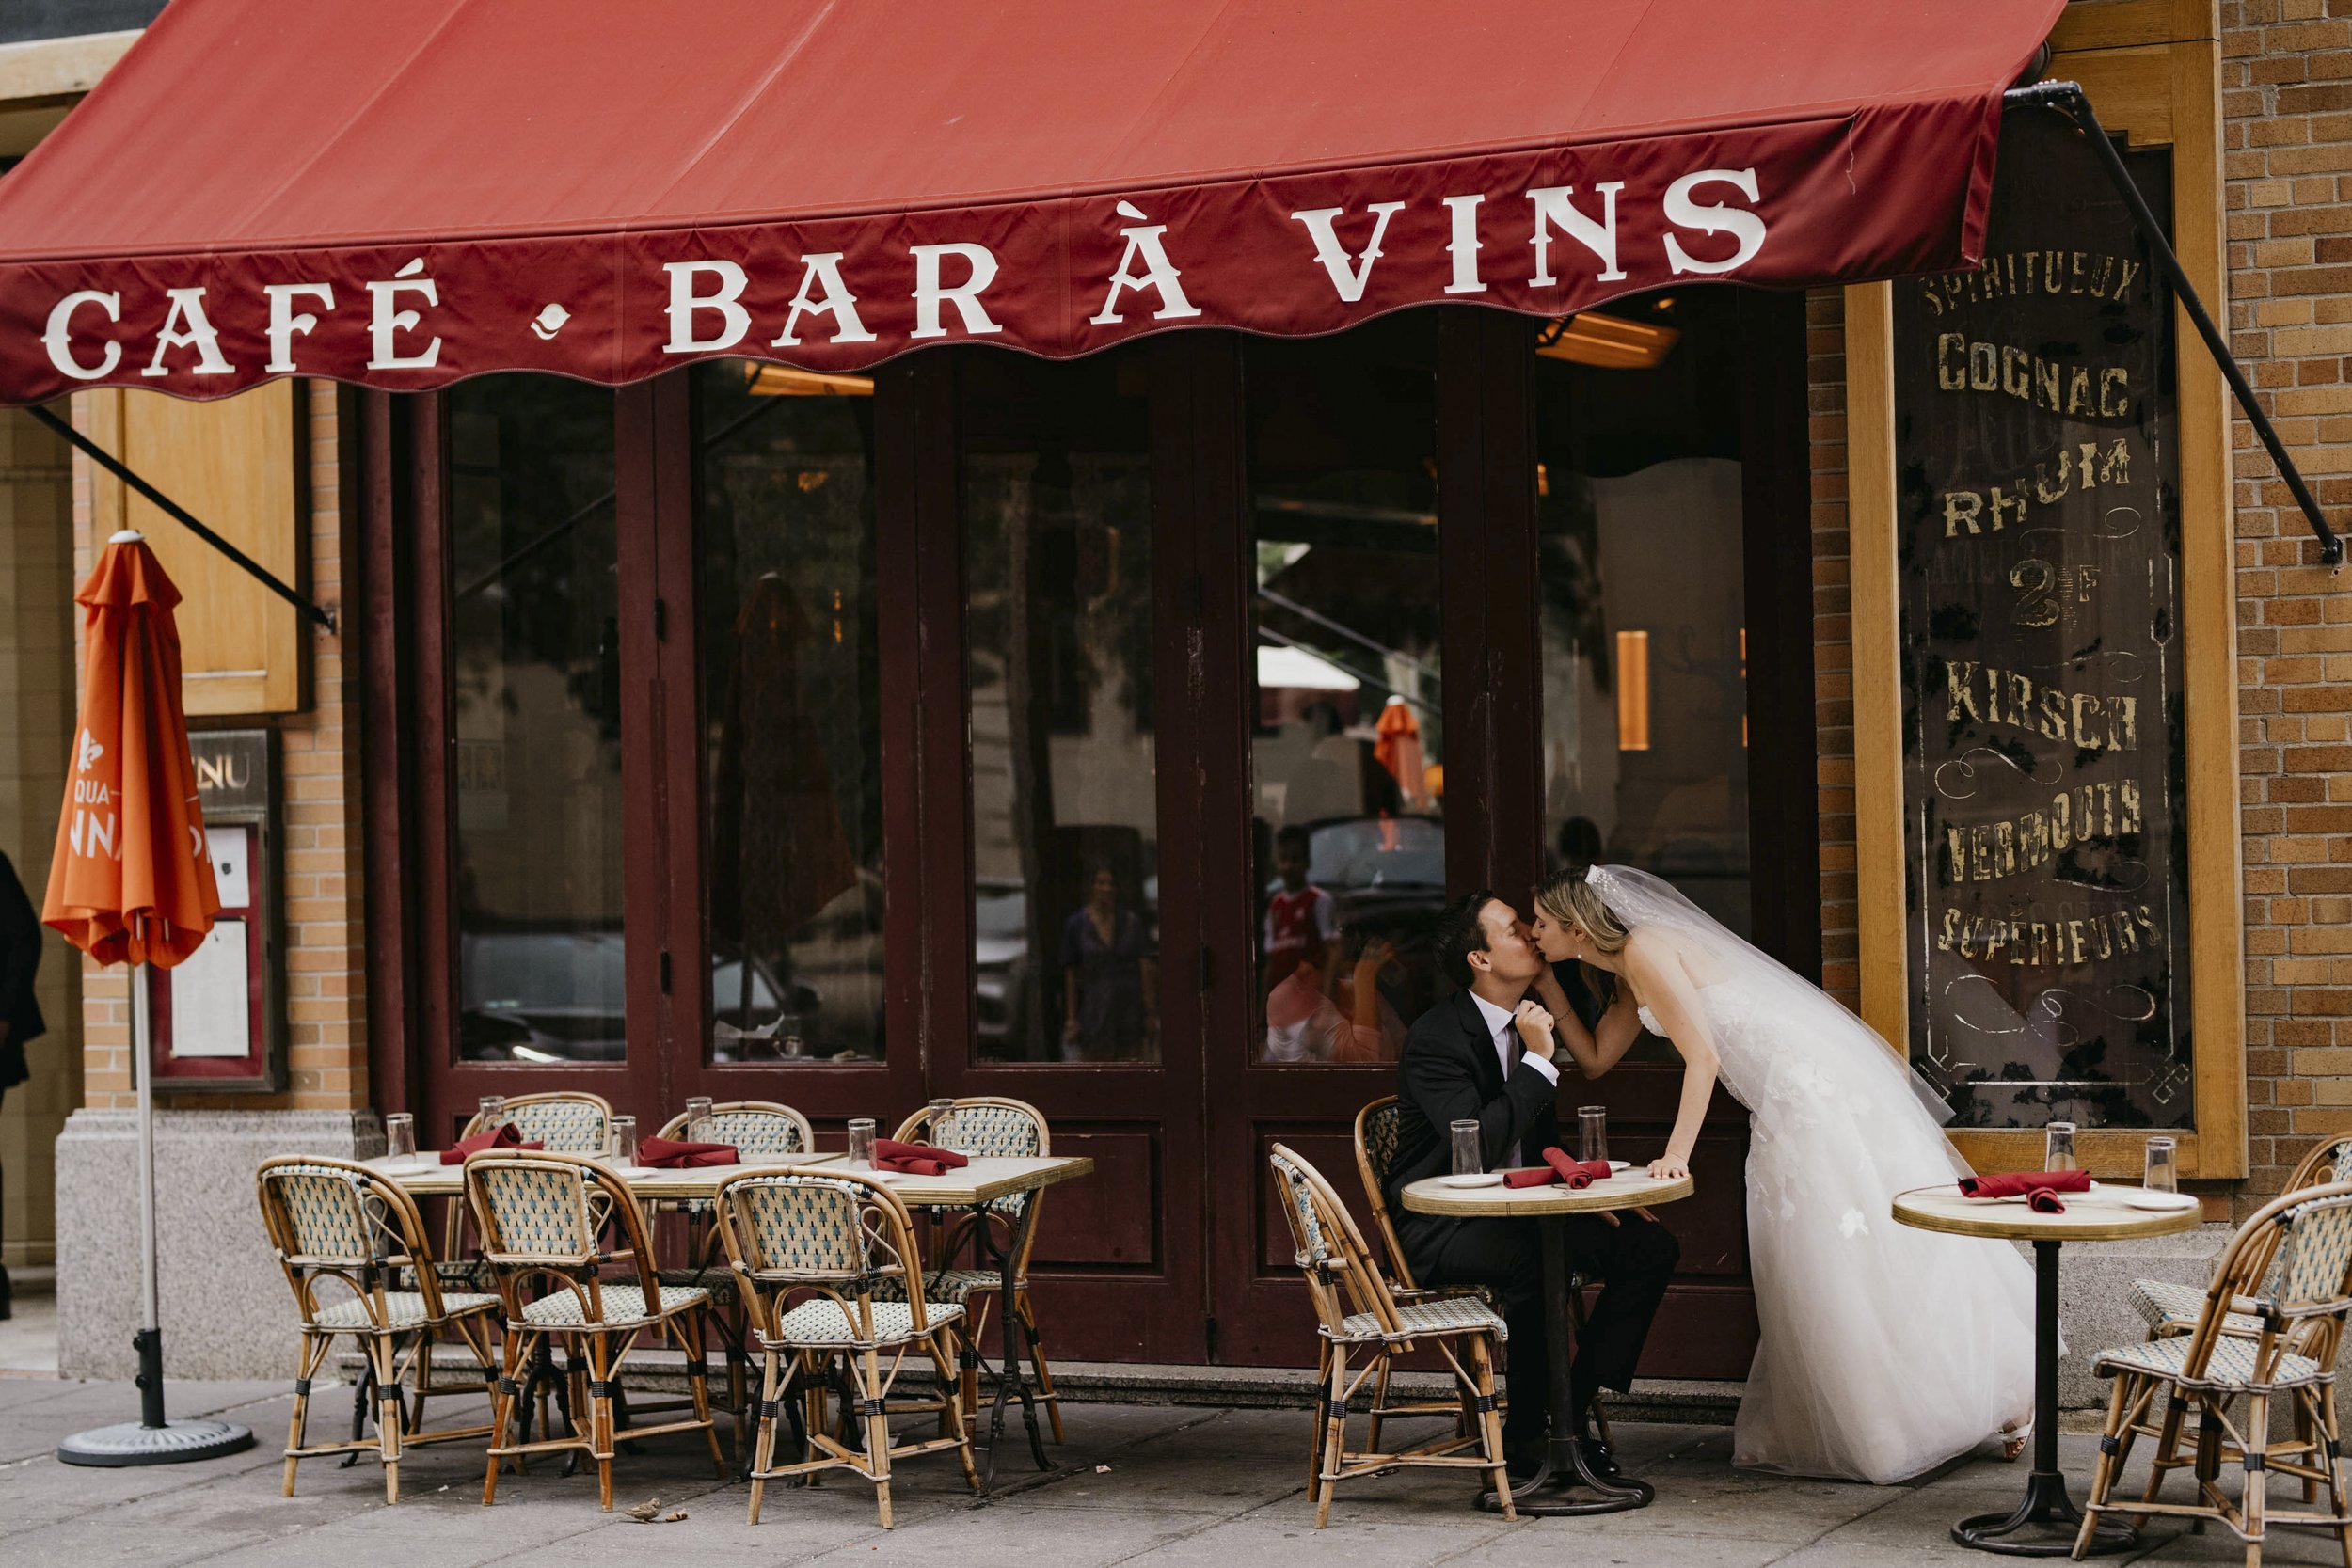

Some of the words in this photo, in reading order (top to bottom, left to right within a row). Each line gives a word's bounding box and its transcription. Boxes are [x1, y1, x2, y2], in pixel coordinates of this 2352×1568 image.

[40, 257, 442, 380] CAFÉ
[661, 242, 1004, 354] BAR
[1089, 199, 1202, 325] À
[1290, 166, 1768, 303] VINS
[1937, 332, 2129, 418] COGNAC
[1943, 438, 2131, 539] RHUM
[1945, 660, 2137, 752] KIRSCH
[74, 779, 110, 806] QUA
[191, 753, 250, 790] NU
[1947, 779, 2142, 883] VERMOUTH
[1938, 905, 2163, 966] SUPÉRIEURS
